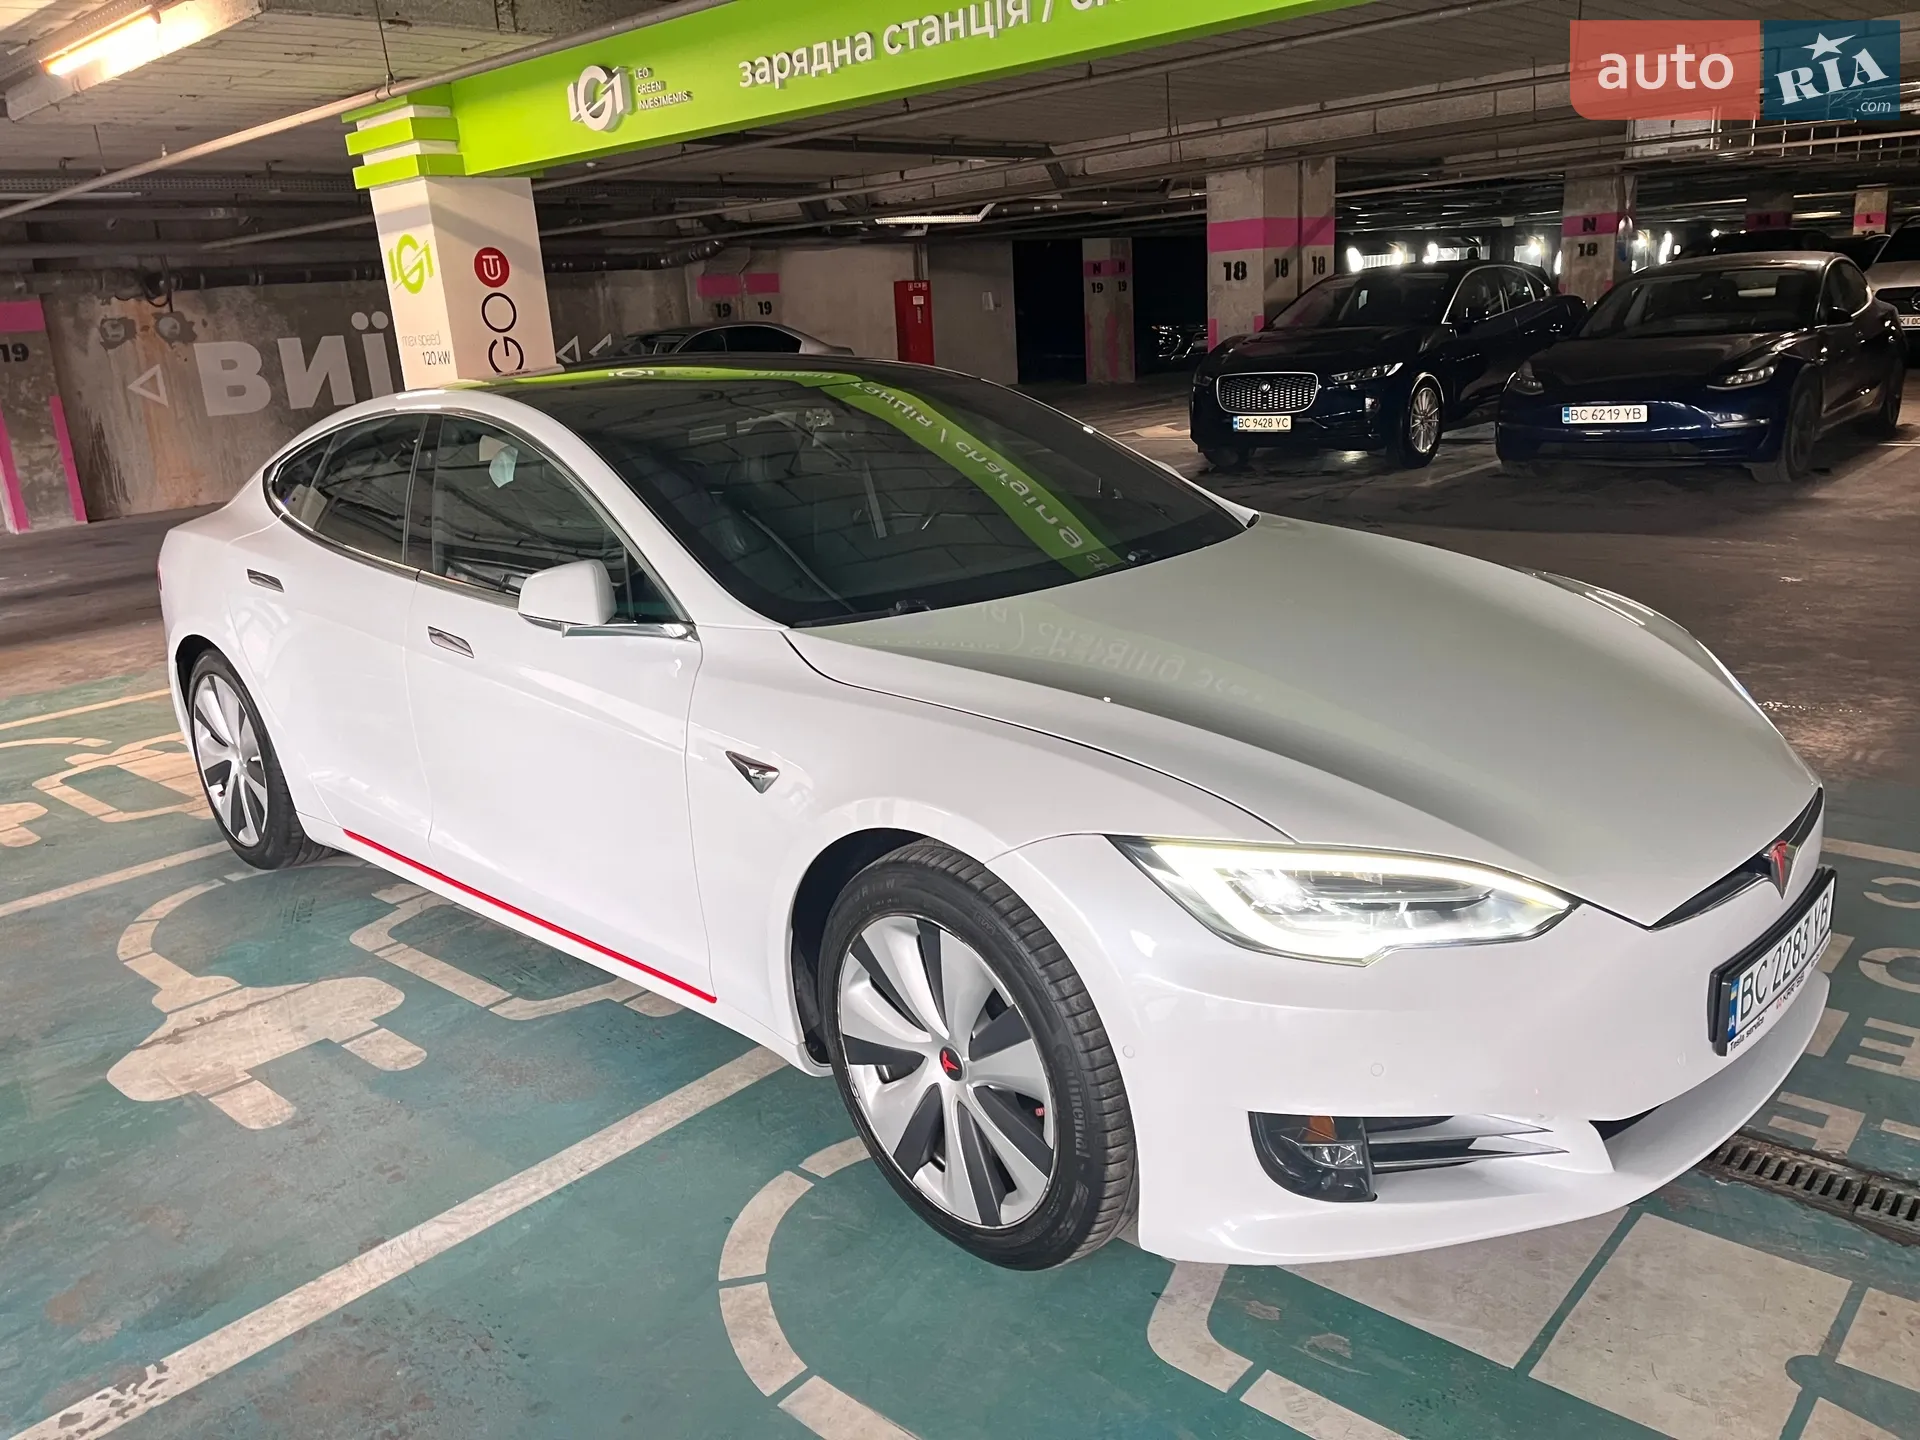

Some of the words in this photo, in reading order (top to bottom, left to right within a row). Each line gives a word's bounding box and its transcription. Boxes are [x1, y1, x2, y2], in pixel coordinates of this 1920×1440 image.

[738, 30, 873, 90] зарядна
[883, 0, 1029, 56] станція
[633, 67, 650, 80] LEO
[636, 82, 663, 95] GREEN
[638, 90, 690, 110] INVESTMENTS
[1582, 216, 1597, 232] N
[1578, 242, 1598, 257] 18
[1092, 262, 1102, 275] N
[1223, 261, 1248, 281] 18
[1274, 258, 1289, 278] 18
[1312, 256, 1326, 275] 18
[1091, 282, 1104, 294] 19
[715, 303, 732, 318] 19
[757, 301, 773, 316] 19
[0, 343, 30, 363] 19
[422, 351, 437, 366] 120
[437, 351, 451, 365] kW
[1570, 409, 1588, 421] BC
[1591, 408, 1621, 421] 6219
[1624, 407, 1642, 420] YB
[1238, 417, 1251, 428] BC
[1252, 417, 1274, 428] 9428
[1275, 417, 1289, 428] YC
[1740, 958, 1769, 1022] BC
[1772, 914, 1810, 992] 2283
[1812, 892, 1829, 945] YB
